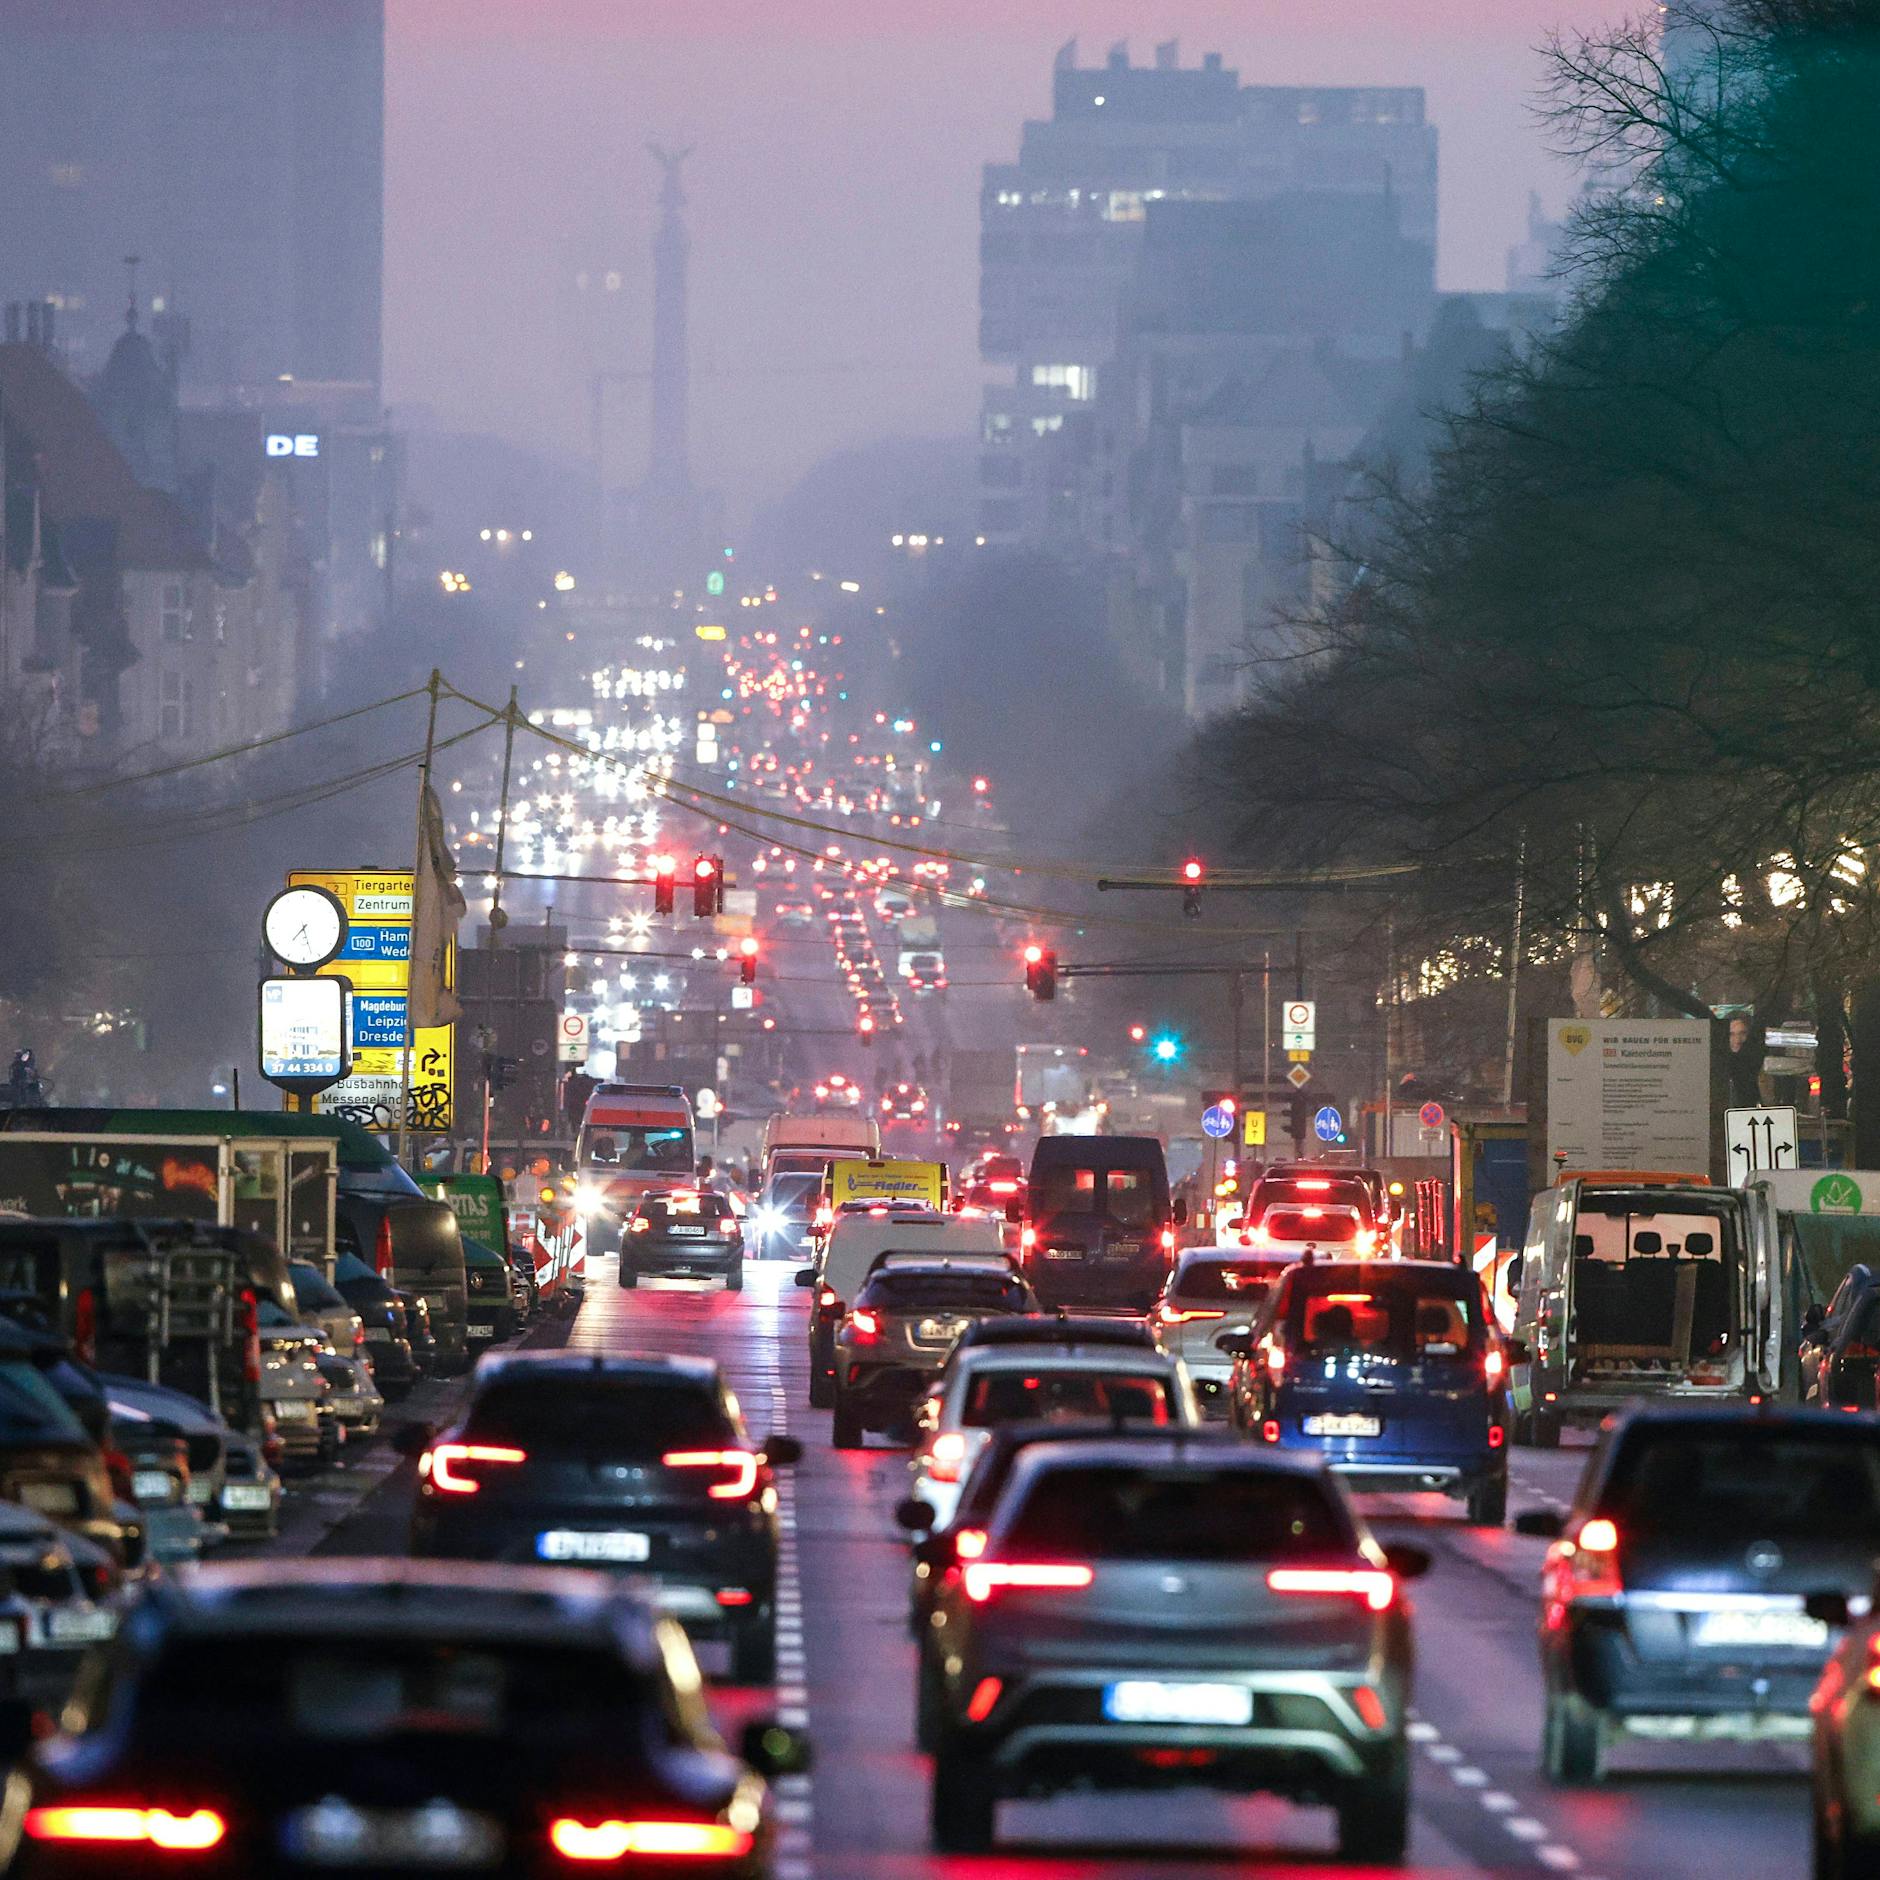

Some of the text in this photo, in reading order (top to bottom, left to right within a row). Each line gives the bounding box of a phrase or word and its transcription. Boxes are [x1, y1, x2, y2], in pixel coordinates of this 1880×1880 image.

[334, 885, 340, 893] 2
[358, 898, 410, 910] Zentrum
[355, 939, 371, 948] 100
[381, 946, 411, 957] Wed
[367, 1015, 407, 1028] Leipzi
[1672, 1037, 1702, 1045] BERLIN
[287, 1063, 301, 1073] 44
[303, 1063, 323, 1073] 334
